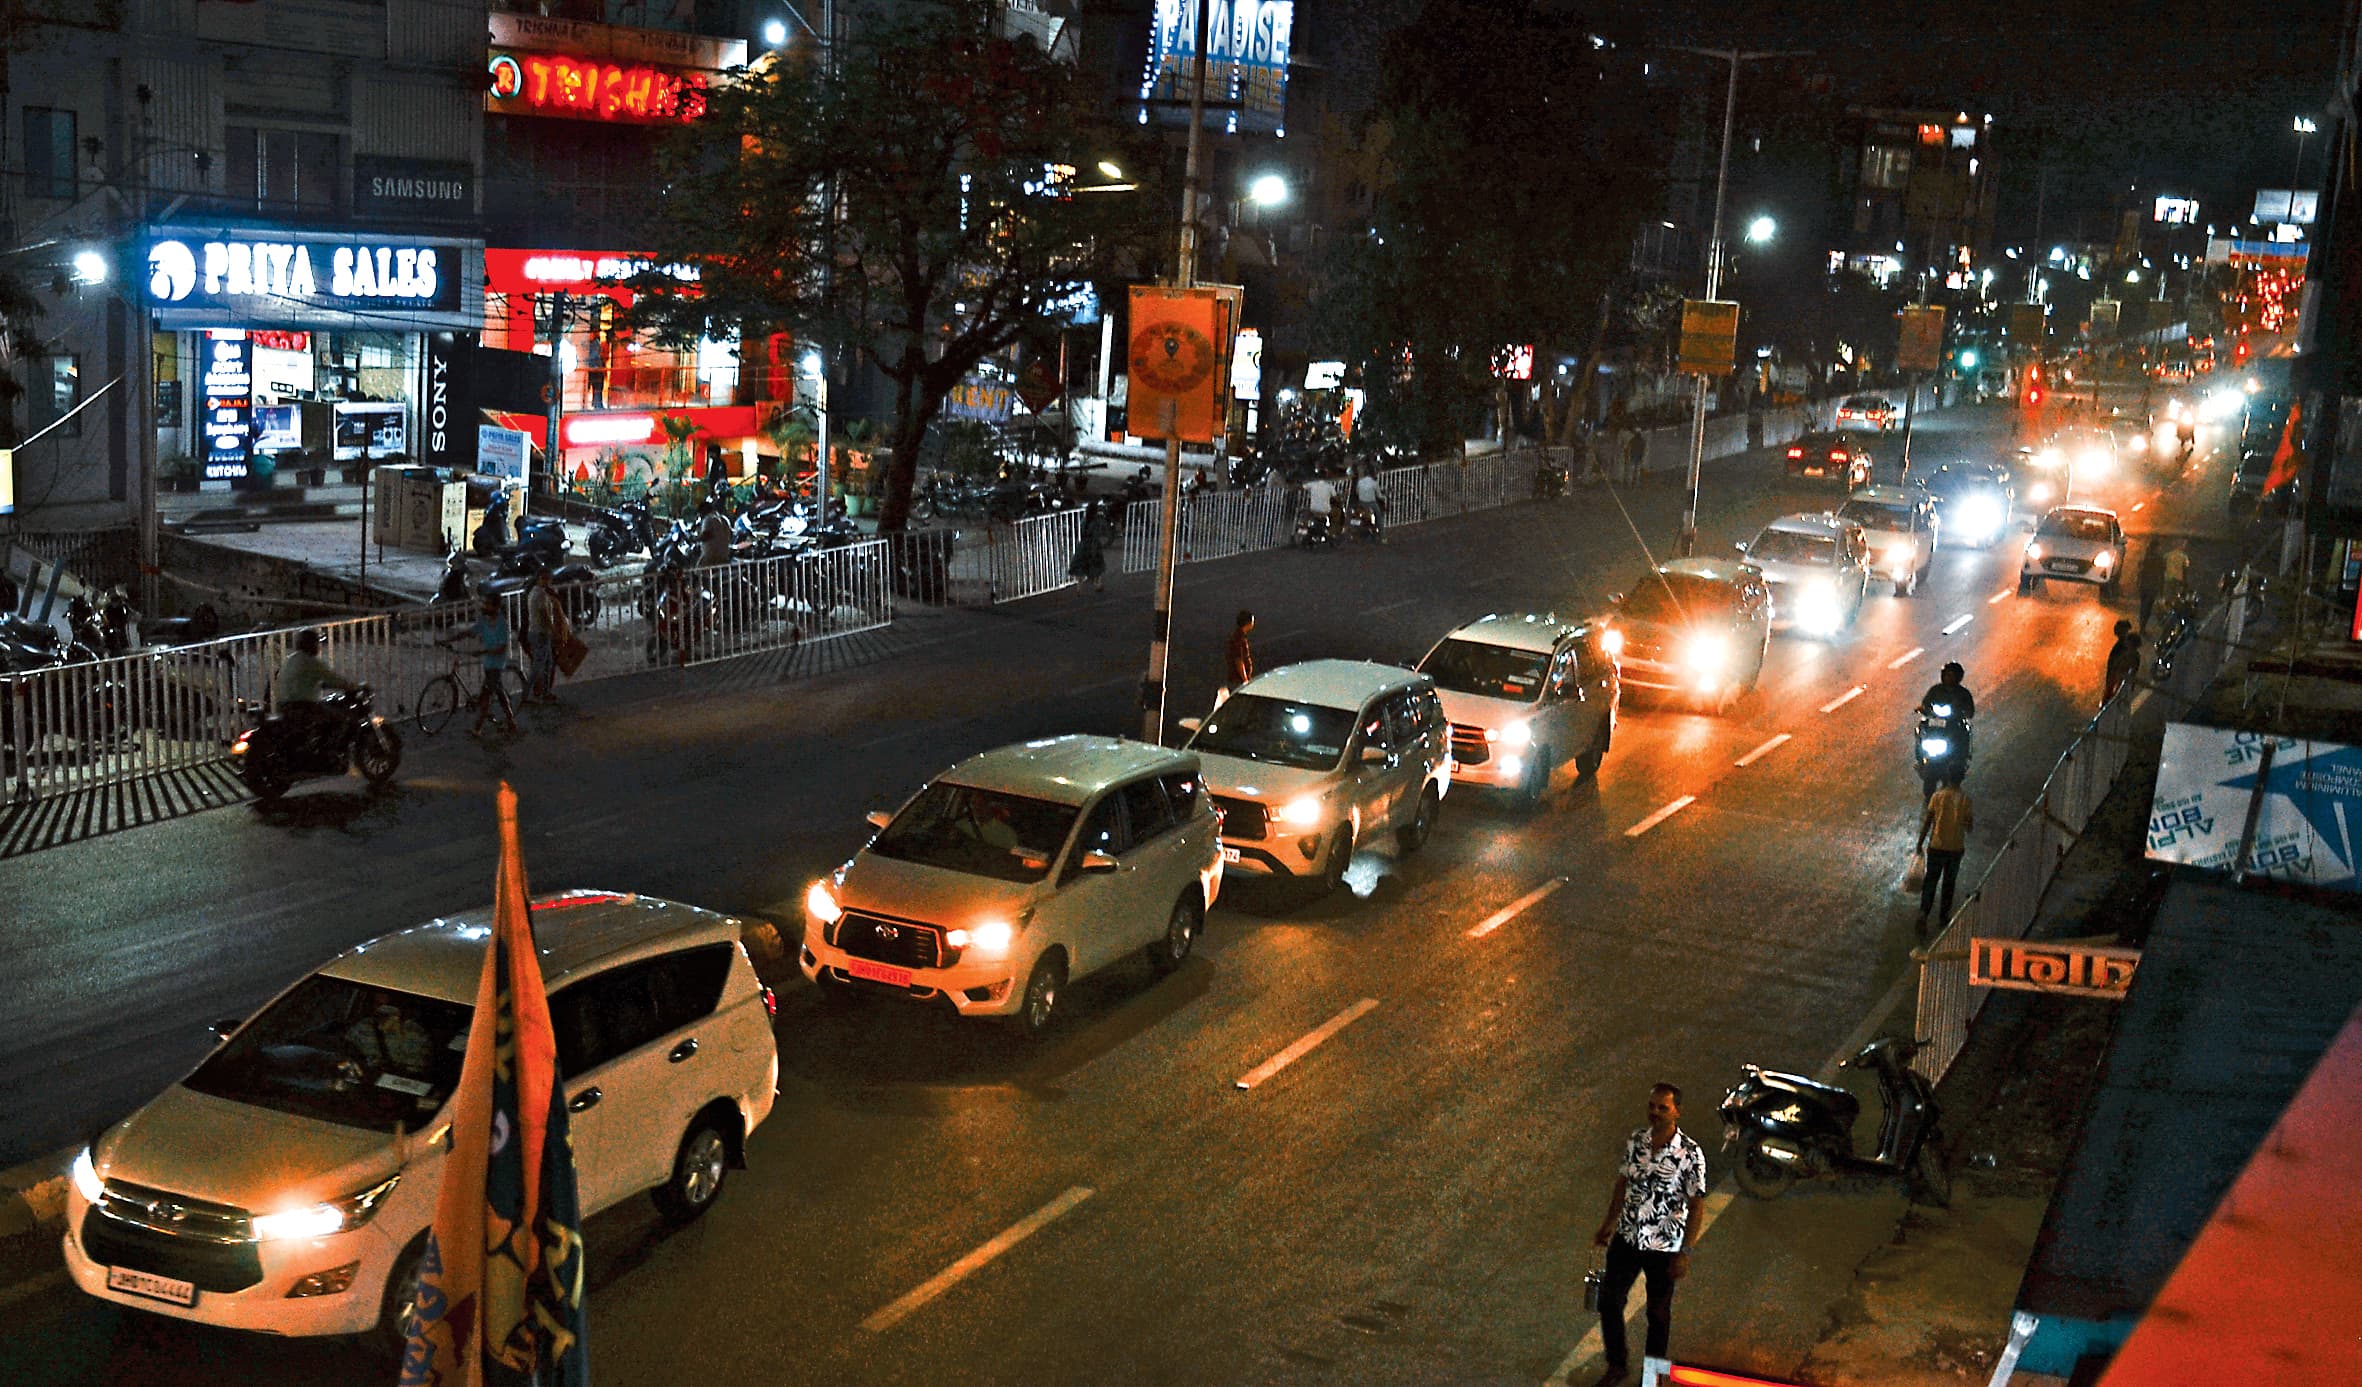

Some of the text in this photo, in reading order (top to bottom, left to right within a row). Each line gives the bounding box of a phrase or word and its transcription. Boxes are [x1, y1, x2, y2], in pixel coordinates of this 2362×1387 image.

[371, 177, 463, 200] SAMSUNG
[203, 242, 437, 298] PRIYA SALES
[431, 354, 447, 452] SONY
